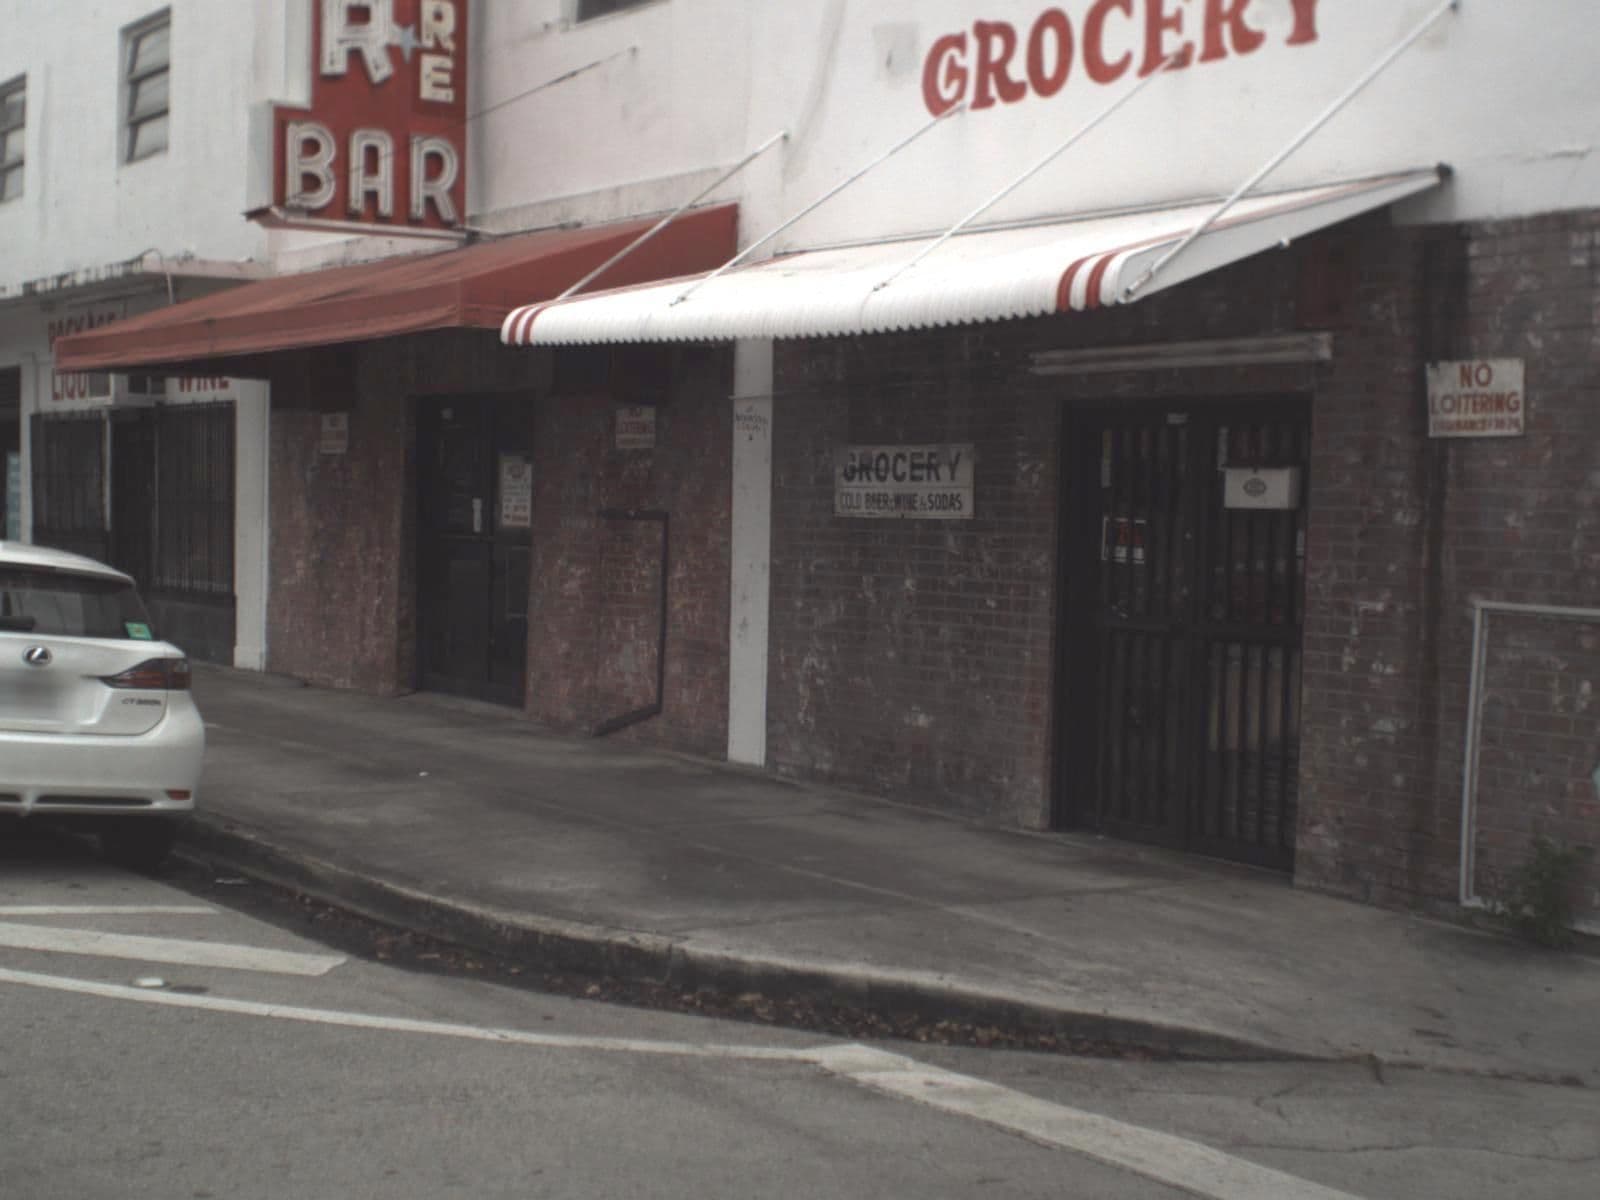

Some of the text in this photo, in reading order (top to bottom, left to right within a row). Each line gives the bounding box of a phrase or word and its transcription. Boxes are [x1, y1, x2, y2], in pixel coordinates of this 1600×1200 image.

[285, 121, 459, 225] BAR
[1459, 362, 1493, 388] NO
[1429, 391, 1521, 416] LOITERING
[843, 451, 961, 483] GROCERY
[927, 491, 963, 512] SODAS
